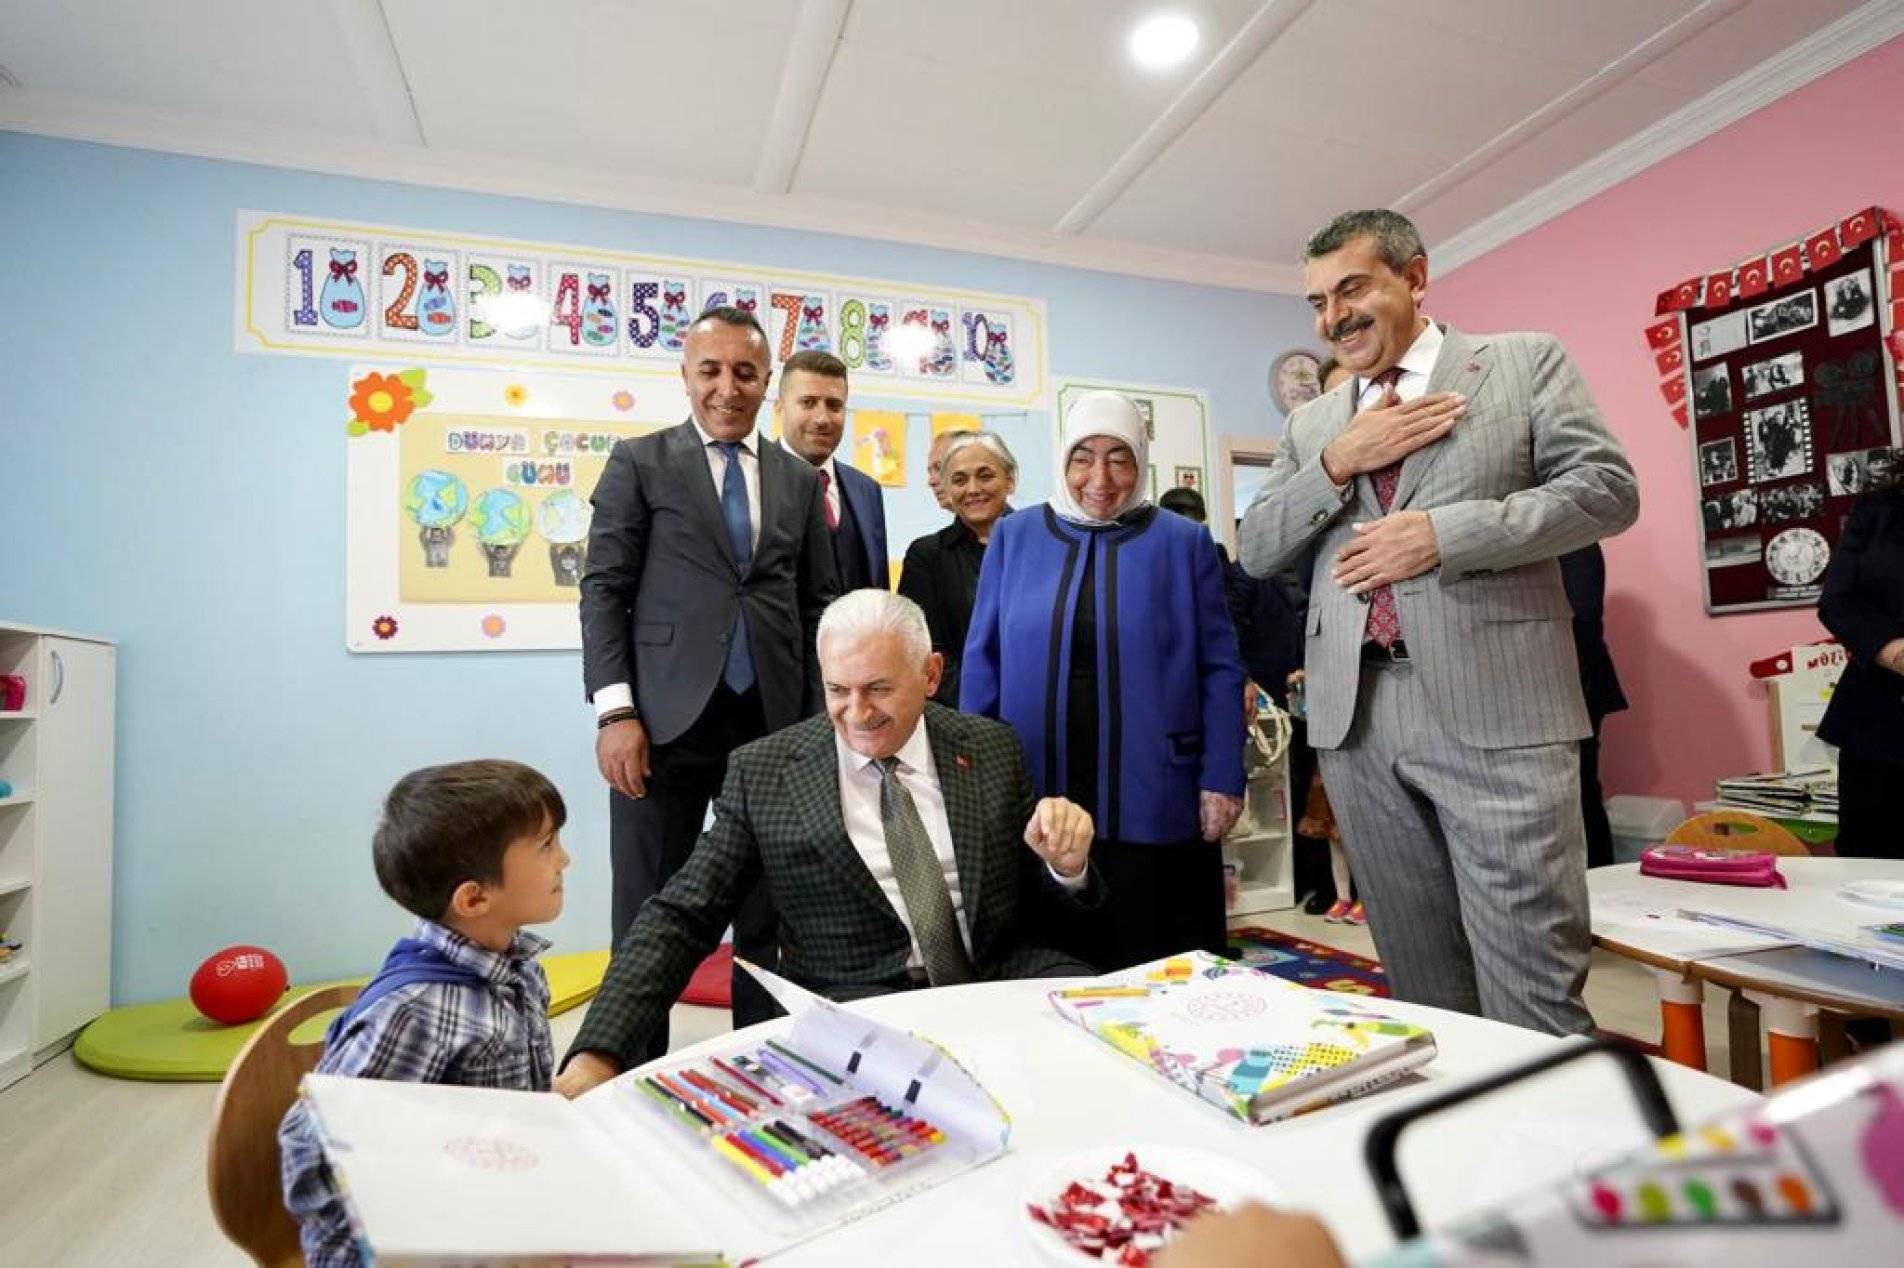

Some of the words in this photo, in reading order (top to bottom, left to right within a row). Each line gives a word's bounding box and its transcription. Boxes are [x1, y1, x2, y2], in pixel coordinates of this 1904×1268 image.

[293, 249, 318, 326] 1
[382, 252, 419, 331] 2
[551, 272, 581, 345] 4
[628, 281, 661, 349] 5
[771, 293, 804, 363] 7
[839, 298, 866, 369] 8
[962, 311, 989, 362] 10
